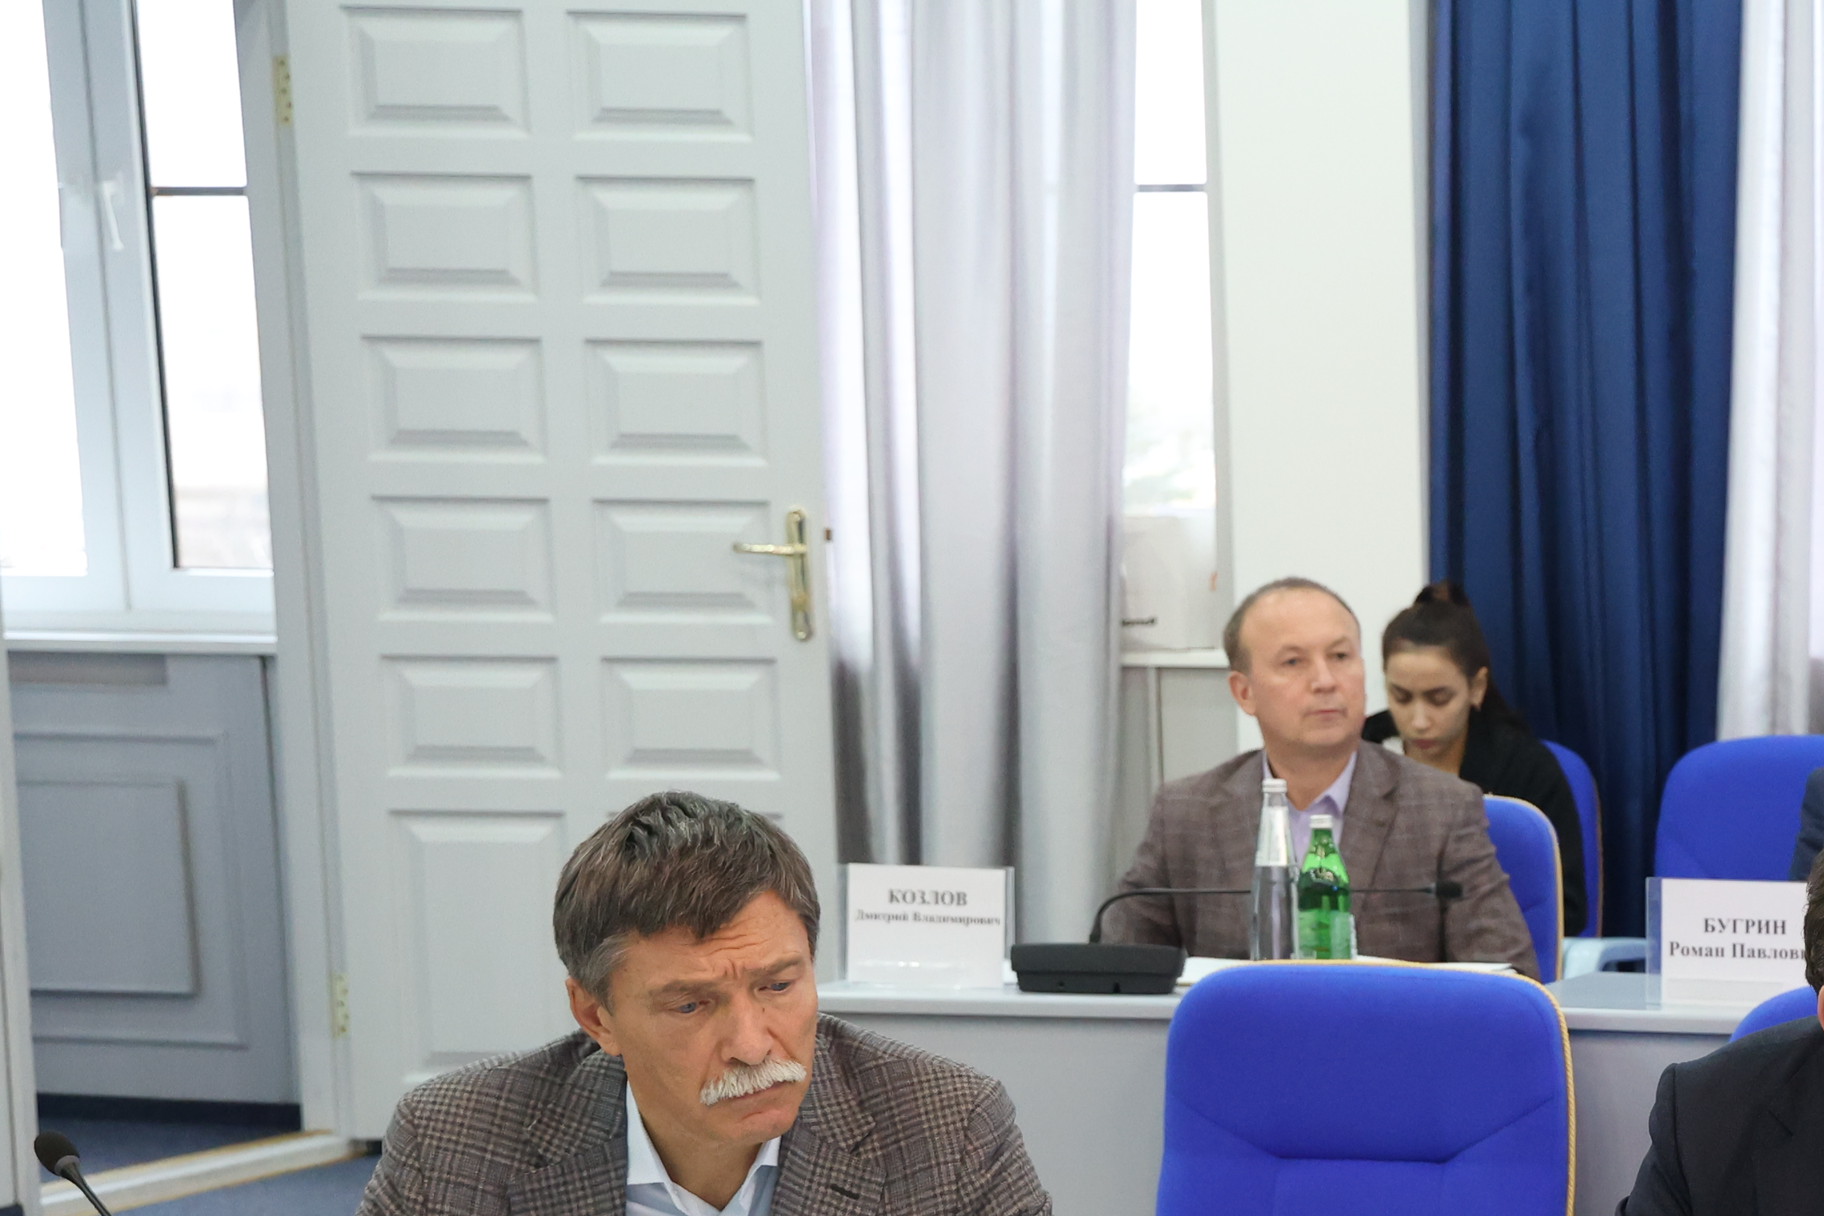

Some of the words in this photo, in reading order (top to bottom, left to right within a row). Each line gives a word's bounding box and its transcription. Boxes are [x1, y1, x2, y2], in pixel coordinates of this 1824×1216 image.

[888, 888, 968, 906] КОЗЛОВ
[855, 909, 909, 925] Дмитрий
[913, 911, 1001, 927] Владимирович
[1704, 917, 1787, 935] БУГРИН
[1669, 941, 1725, 958] Роман
